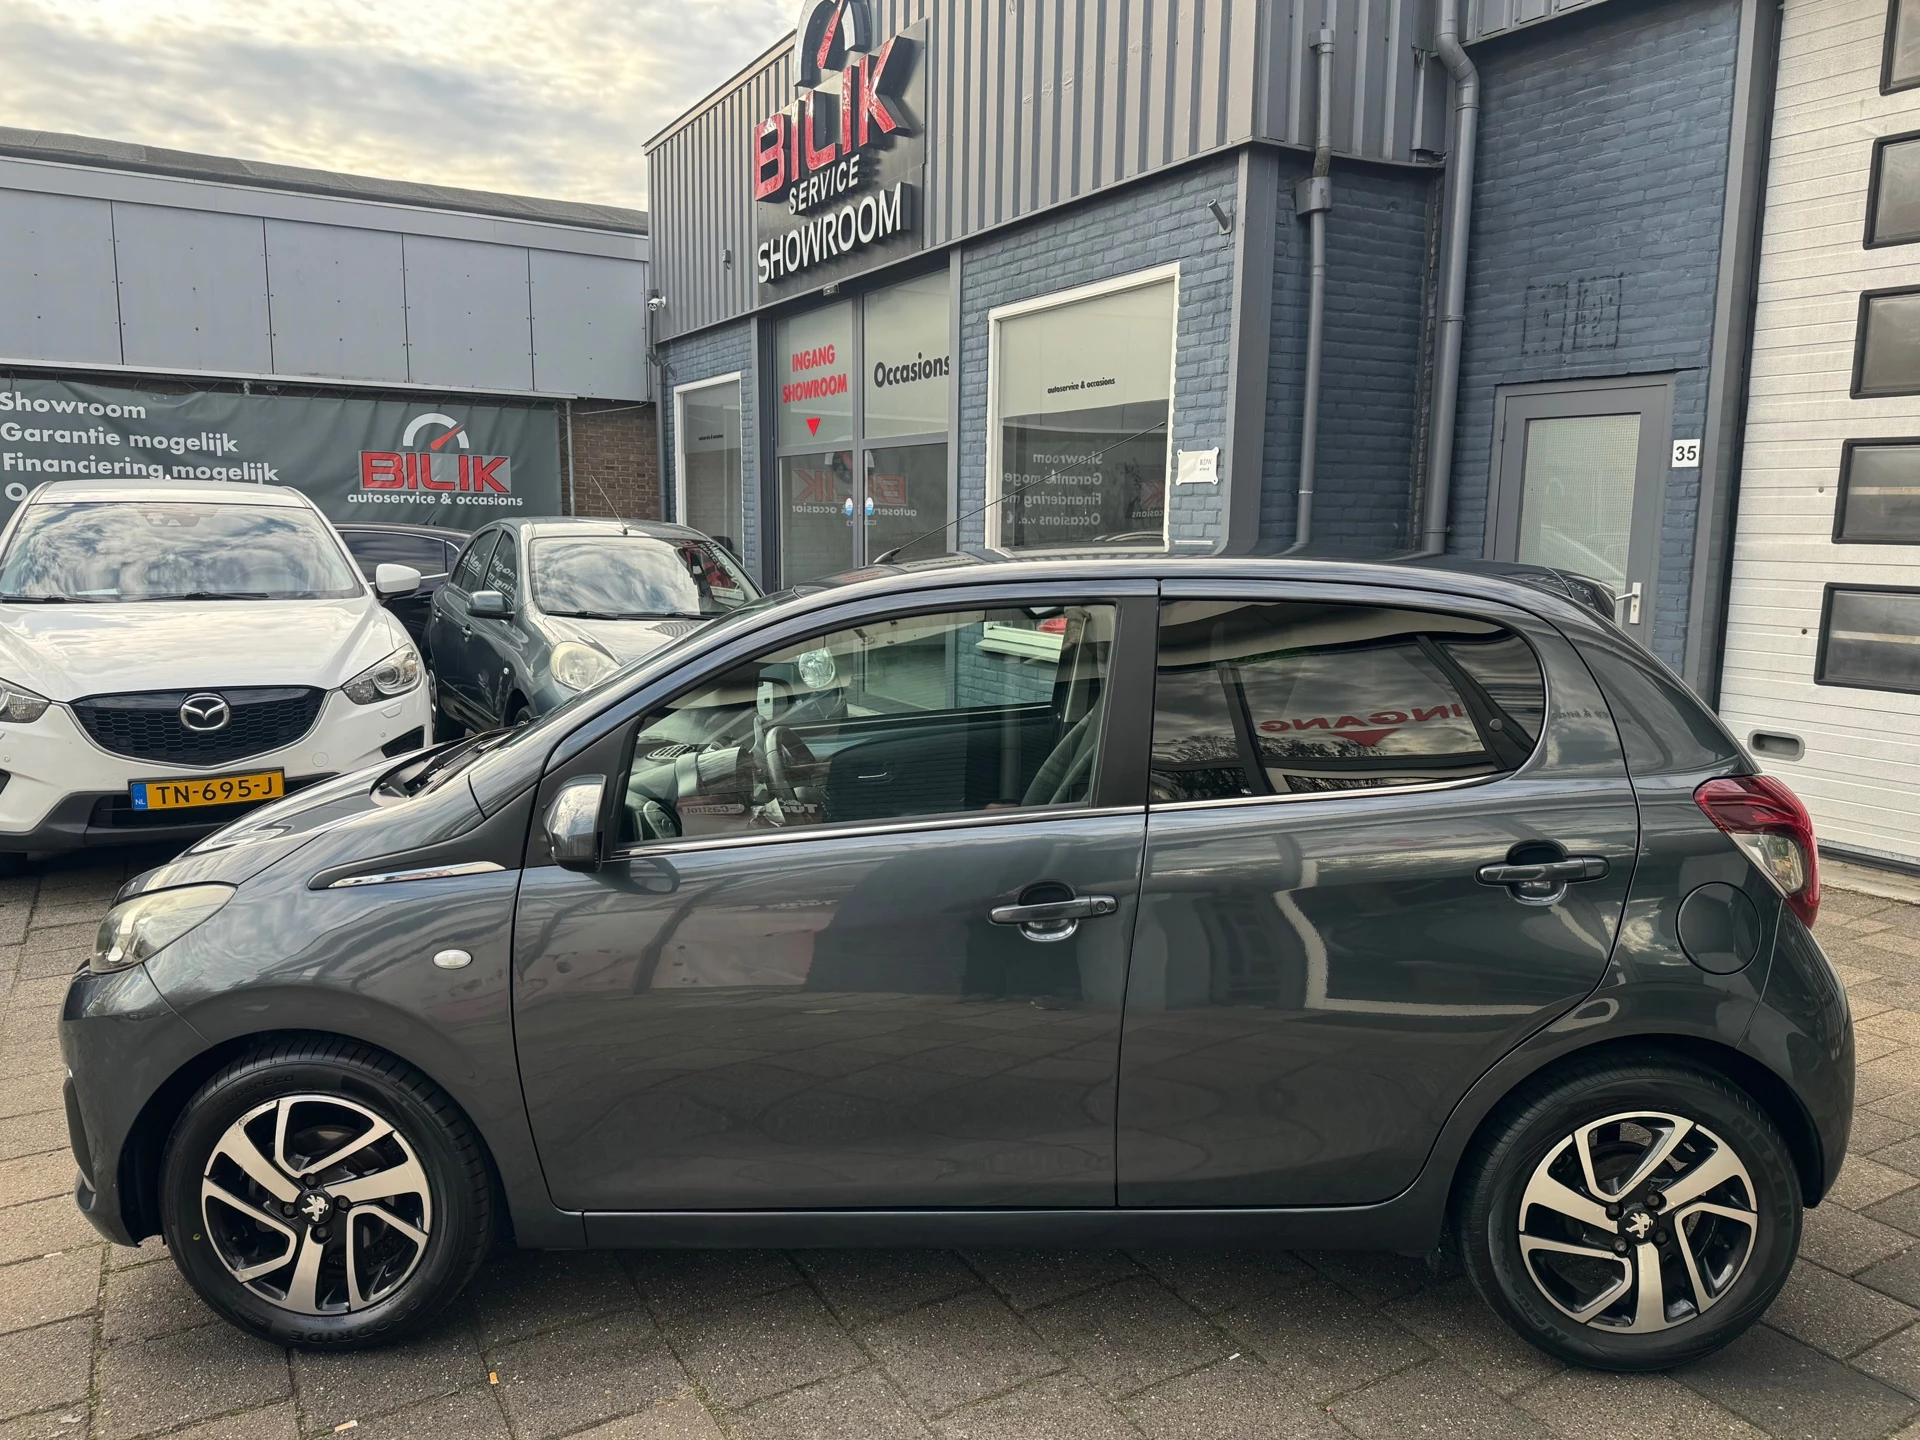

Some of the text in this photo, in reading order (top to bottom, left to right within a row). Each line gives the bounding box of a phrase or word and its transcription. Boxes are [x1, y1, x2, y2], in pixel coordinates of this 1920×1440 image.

[754, 35, 898, 201] BILIK
[788, 154, 860, 215] SERVICE
[757, 181, 902, 284] SHOWROOM
[791, 344, 836, 373] INGANG
[873, 352, 950, 388] Occasions
[782, 373, 848, 404] SHOWROOM
[1047, 377, 1116, 394] autoservice & occasions
[0, 391, 146, 419] Showroom
[0, 422, 239, 457] Garantie mogelijk
[1675, 445, 1697, 462] 35
[3, 452, 279, 485] Financiering mogelijk
[361, 451, 510, 493] BILIK
[347, 492, 523, 506] autoservice & occasions
[156, 776, 273, 805] TN-695-J
